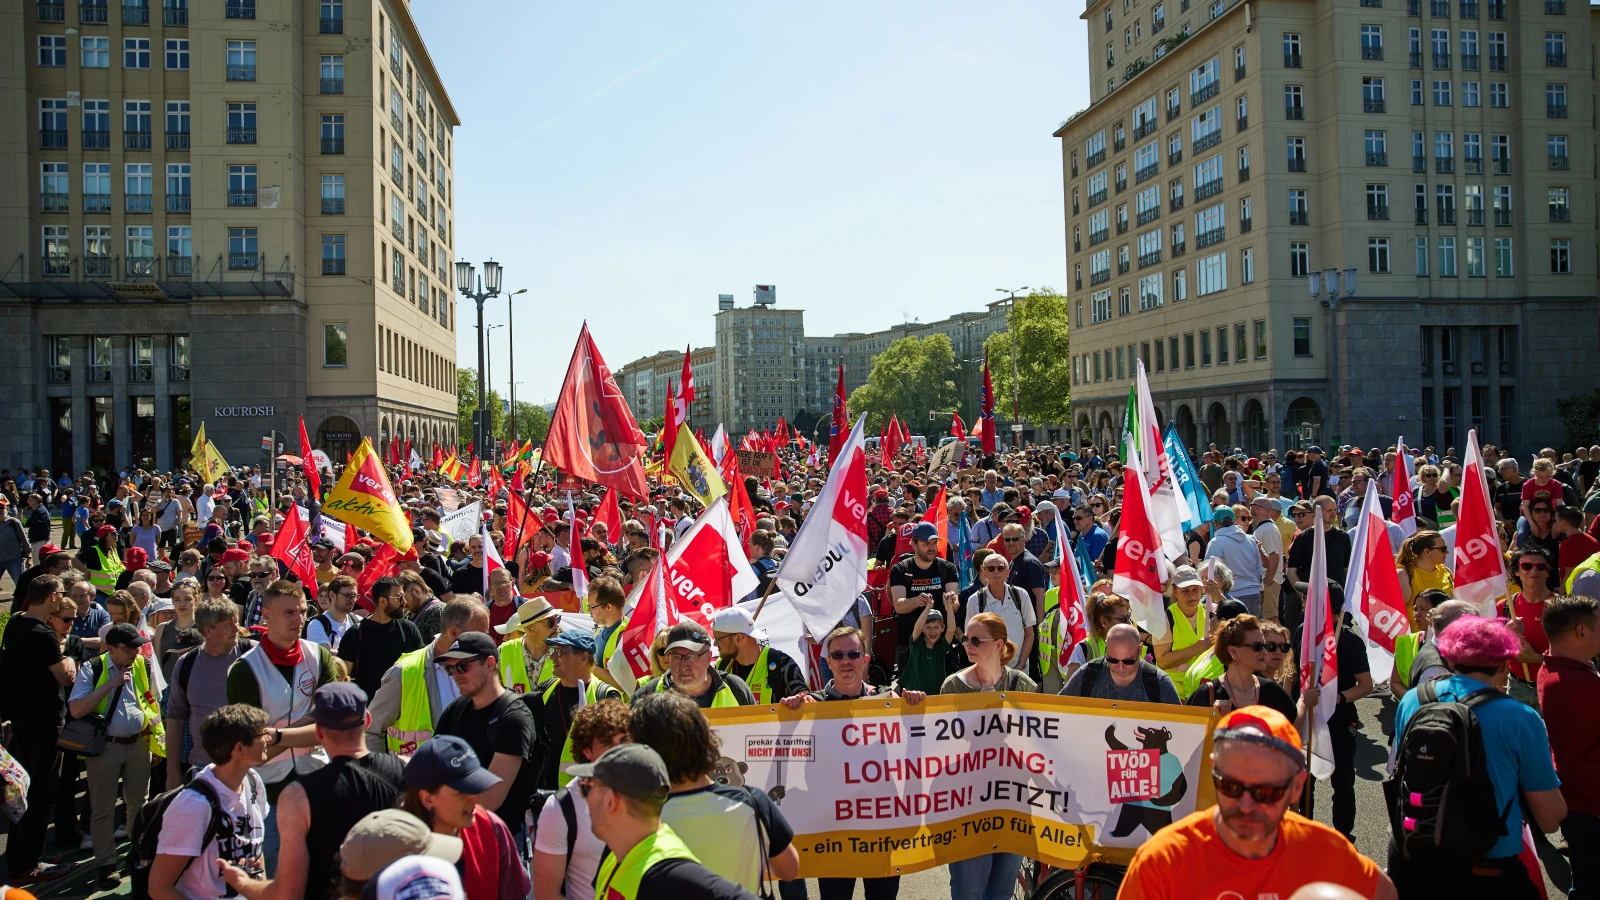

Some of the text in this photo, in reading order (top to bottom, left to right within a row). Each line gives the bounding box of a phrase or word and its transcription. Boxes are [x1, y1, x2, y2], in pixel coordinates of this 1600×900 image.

[214, 406, 275, 417] KOUROSH
[753, 450, 774, 460] KRAFT
[841, 714, 1060, 747] CFM = 20 JAHRE
[748, 738, 773, 747] prekär
[783, 738, 812, 746] tariffrei
[748, 747, 812, 757] NICHT MIT UNS!
[1107, 751, 1150, 769] TVÖD
[844, 747, 1054, 784] LOHNDUMPING:
[1121, 768, 1138, 779] FÜR
[1110, 766, 1158, 798] ALLE!
[835, 780, 1069, 821] BEENDEN! JETZT!
[814, 839, 843, 854] ein
[848, 829, 957, 854] Tarifvertrag:
[961, 816, 1005, 837] TVöD
[1010, 817, 1036, 835] für
[1040, 825, 1082, 847] Alle!
